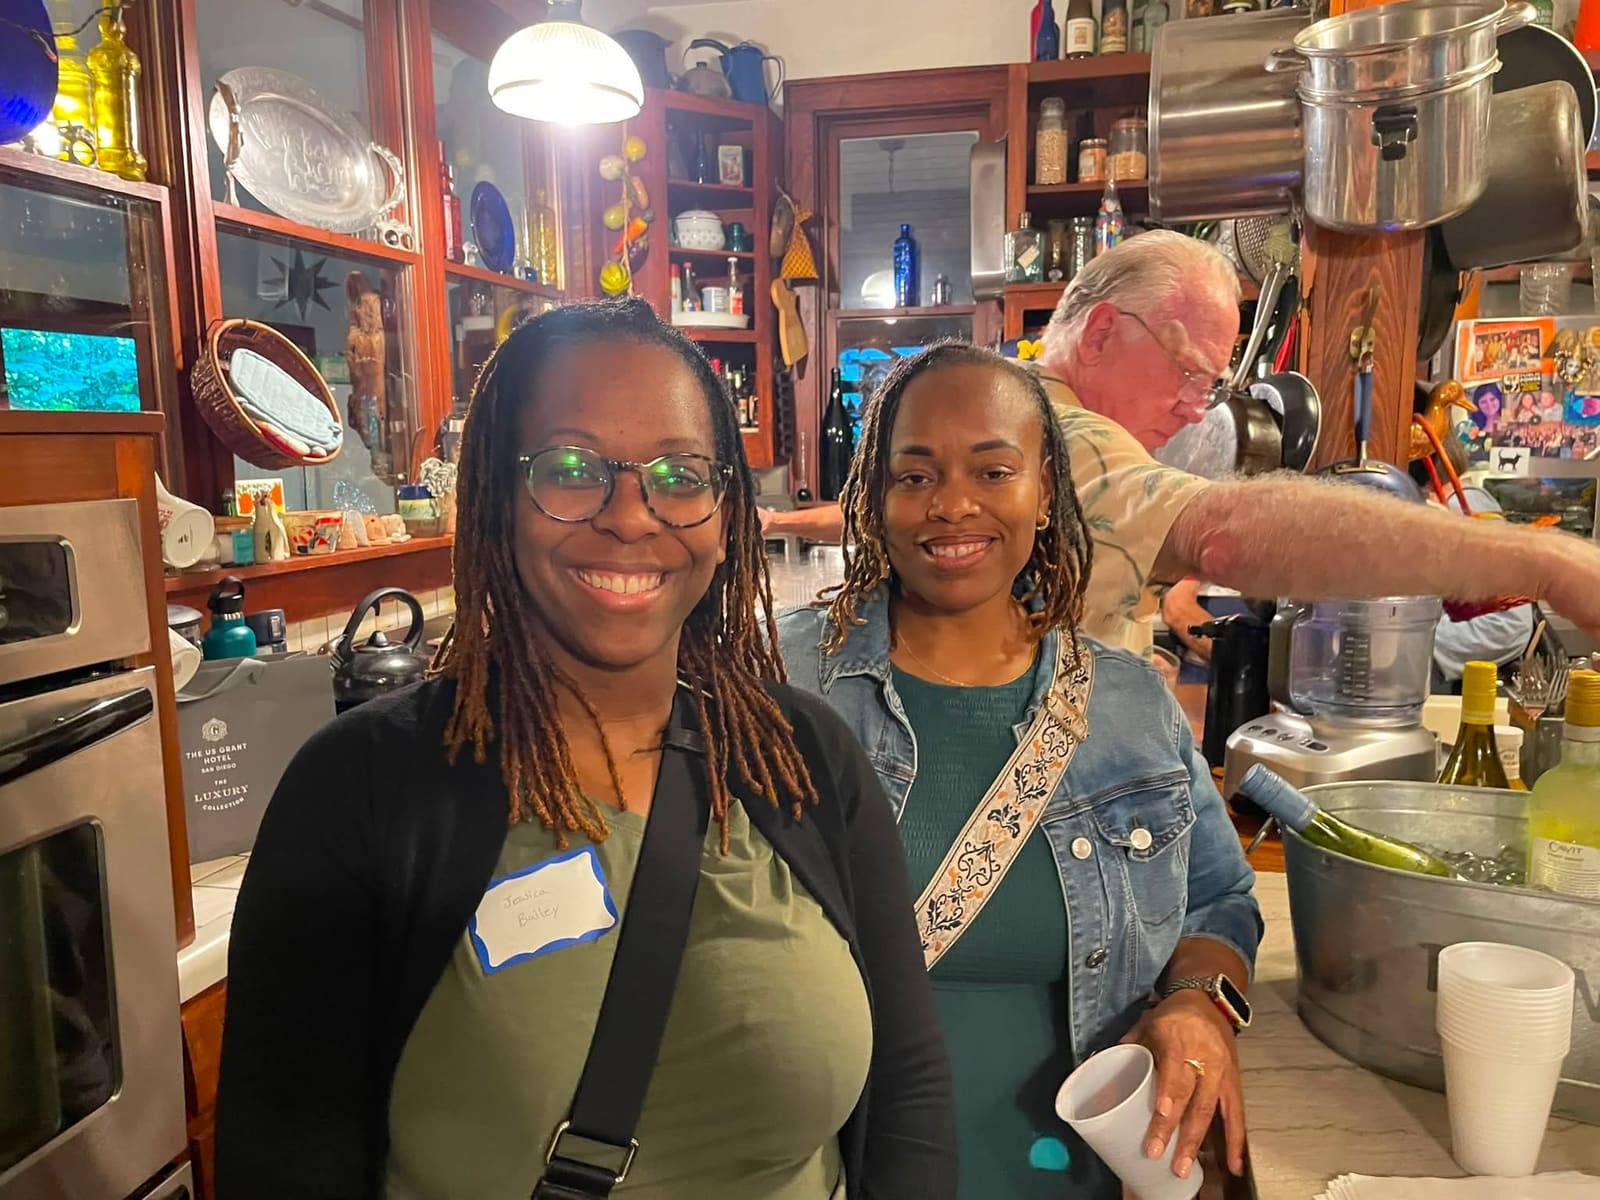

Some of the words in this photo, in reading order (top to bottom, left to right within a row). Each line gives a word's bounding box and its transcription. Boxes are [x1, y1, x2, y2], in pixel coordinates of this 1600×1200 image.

[185, 750, 202, 760] THE
[205, 748, 217, 756] US
[203, 753, 232, 765] HOTEL
[215, 762, 237, 772] DIEGO
[214, 778, 228, 786] THE
[194, 784, 249, 803] LUXURY
[202, 796, 245, 811] COLLECTION
